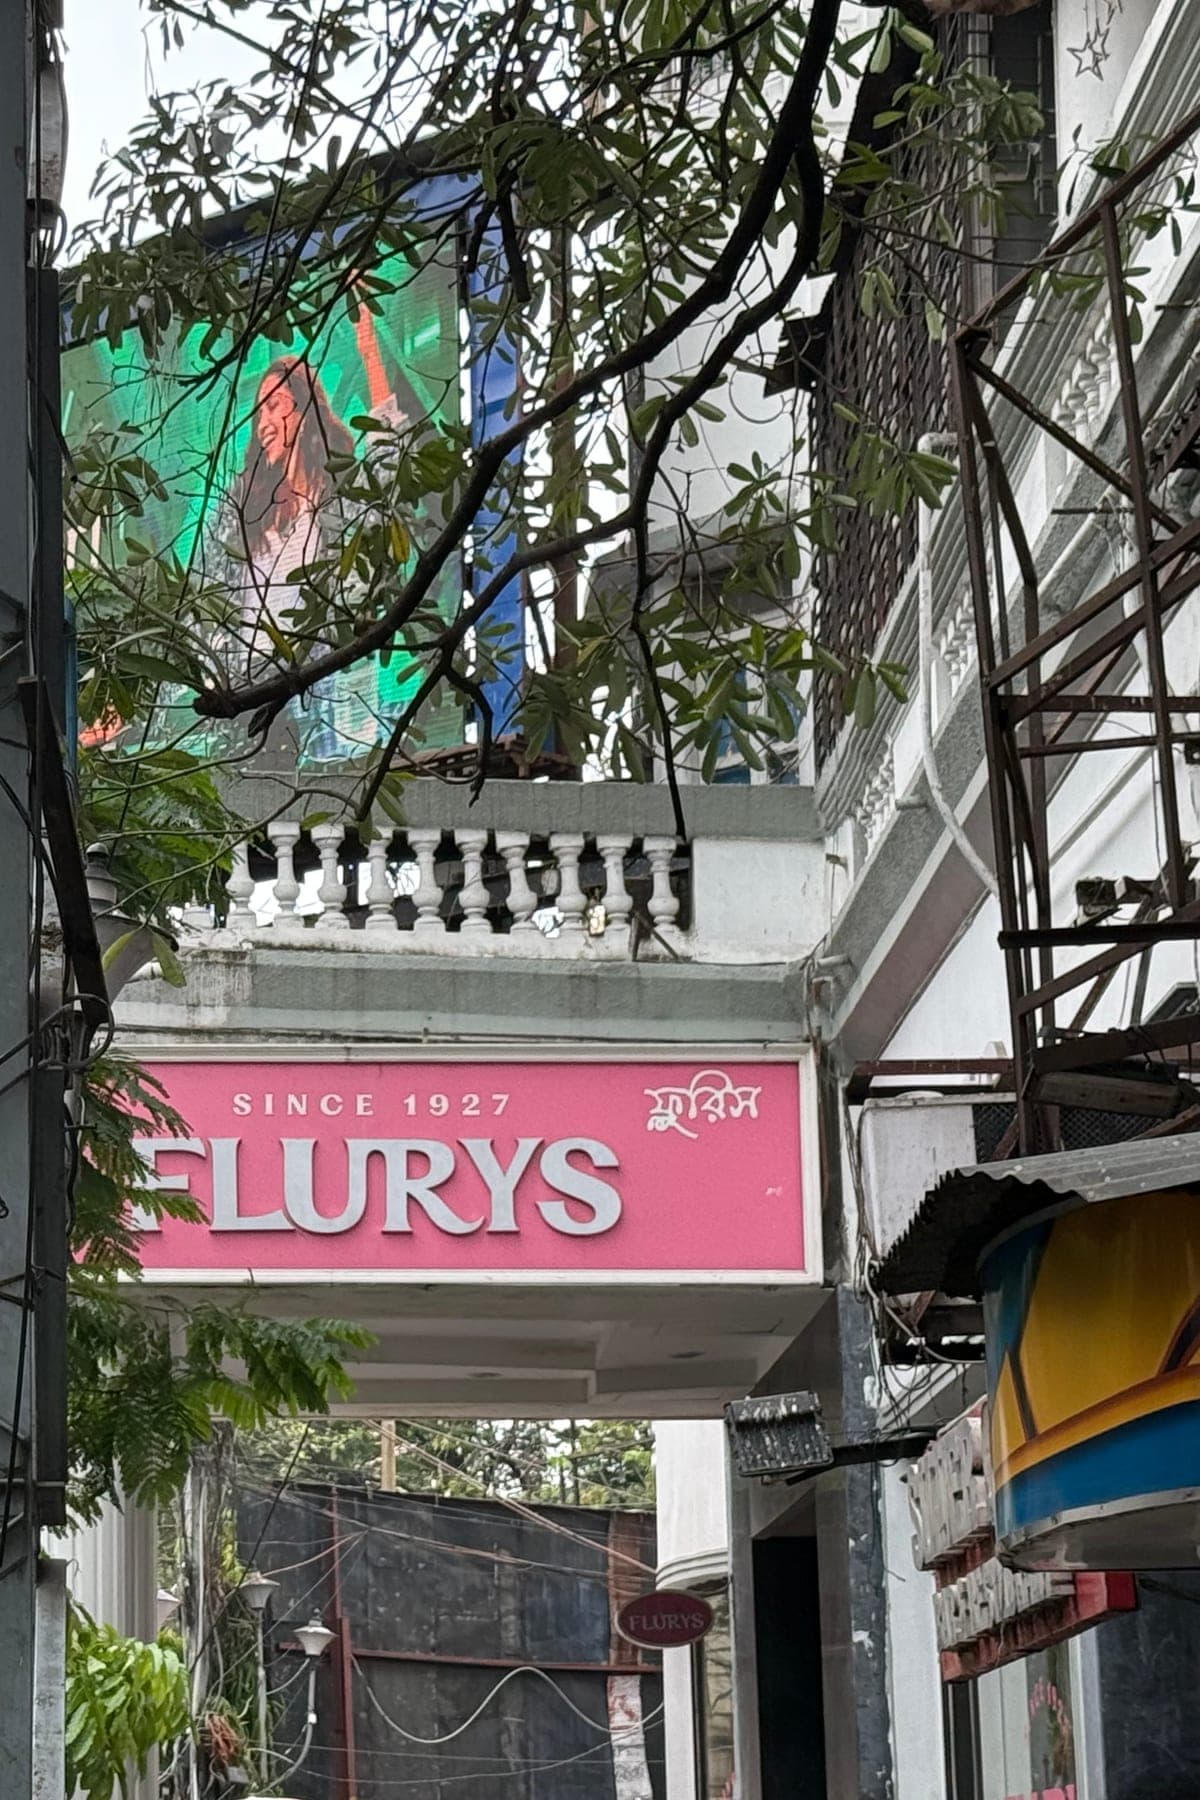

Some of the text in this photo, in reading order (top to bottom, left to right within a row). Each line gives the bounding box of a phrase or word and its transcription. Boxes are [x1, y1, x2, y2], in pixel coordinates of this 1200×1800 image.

[232, 1093, 510, 1116] SINCE 1927
[128, 1136, 622, 1237] FLURYS
[629, 1611, 705, 1631] FLURYS
